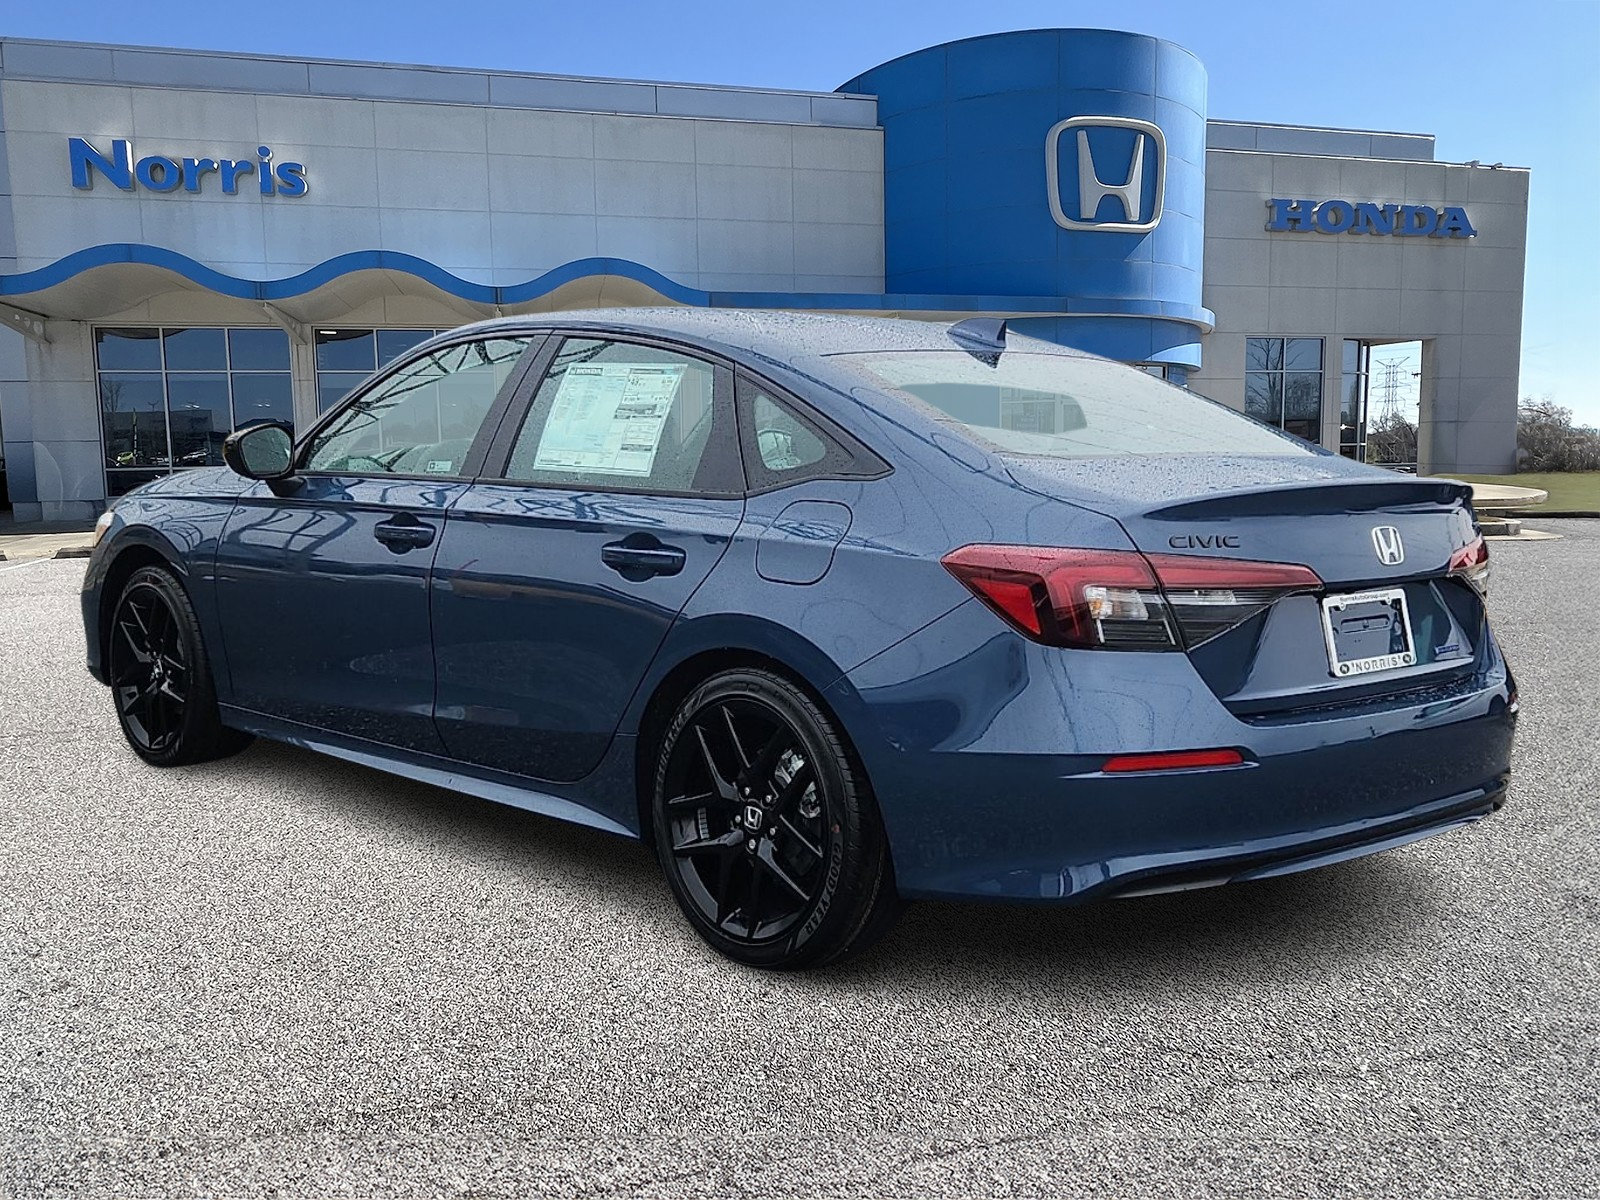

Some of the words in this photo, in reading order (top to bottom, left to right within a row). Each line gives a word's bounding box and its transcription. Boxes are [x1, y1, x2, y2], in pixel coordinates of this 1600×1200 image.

[68, 137, 309, 197] Norris
[1265, 198, 1478, 240] HONDA
[1168, 534, 1241, 549] CIVIC
